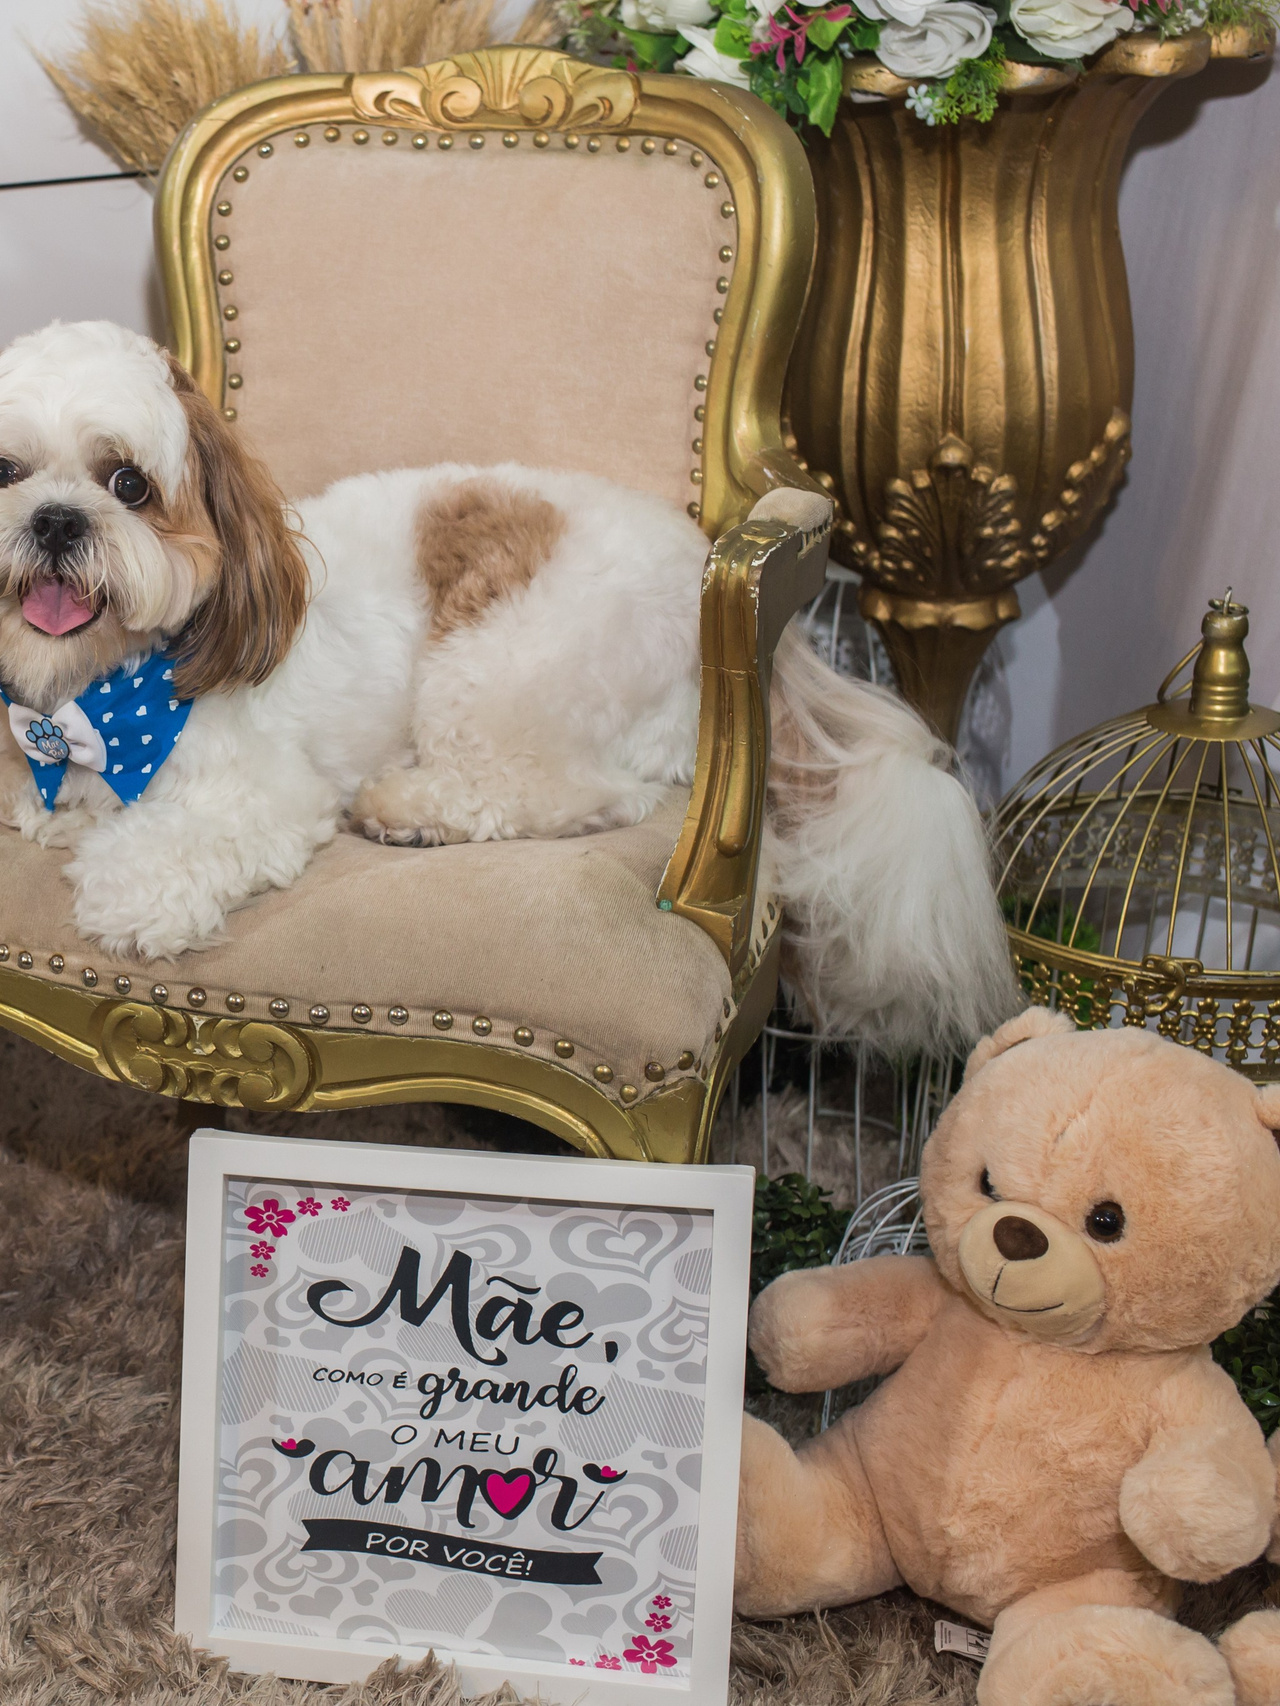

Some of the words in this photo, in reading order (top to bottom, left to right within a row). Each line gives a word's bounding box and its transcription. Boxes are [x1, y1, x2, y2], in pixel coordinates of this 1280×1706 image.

[307, 1246, 618, 1366] Mãe,
[312, 1367, 383, 1388] COMO
[392, 1371, 408, 1389] É
[417, 1364, 606, 1420] grande
[390, 1424, 418, 1445] O
[433, 1428, 520, 1455] MEU
[308, 1447, 606, 1532] amor
[366, 1532, 429, 1558] POR
[443, 1545, 534, 1575] VOCÊ!
